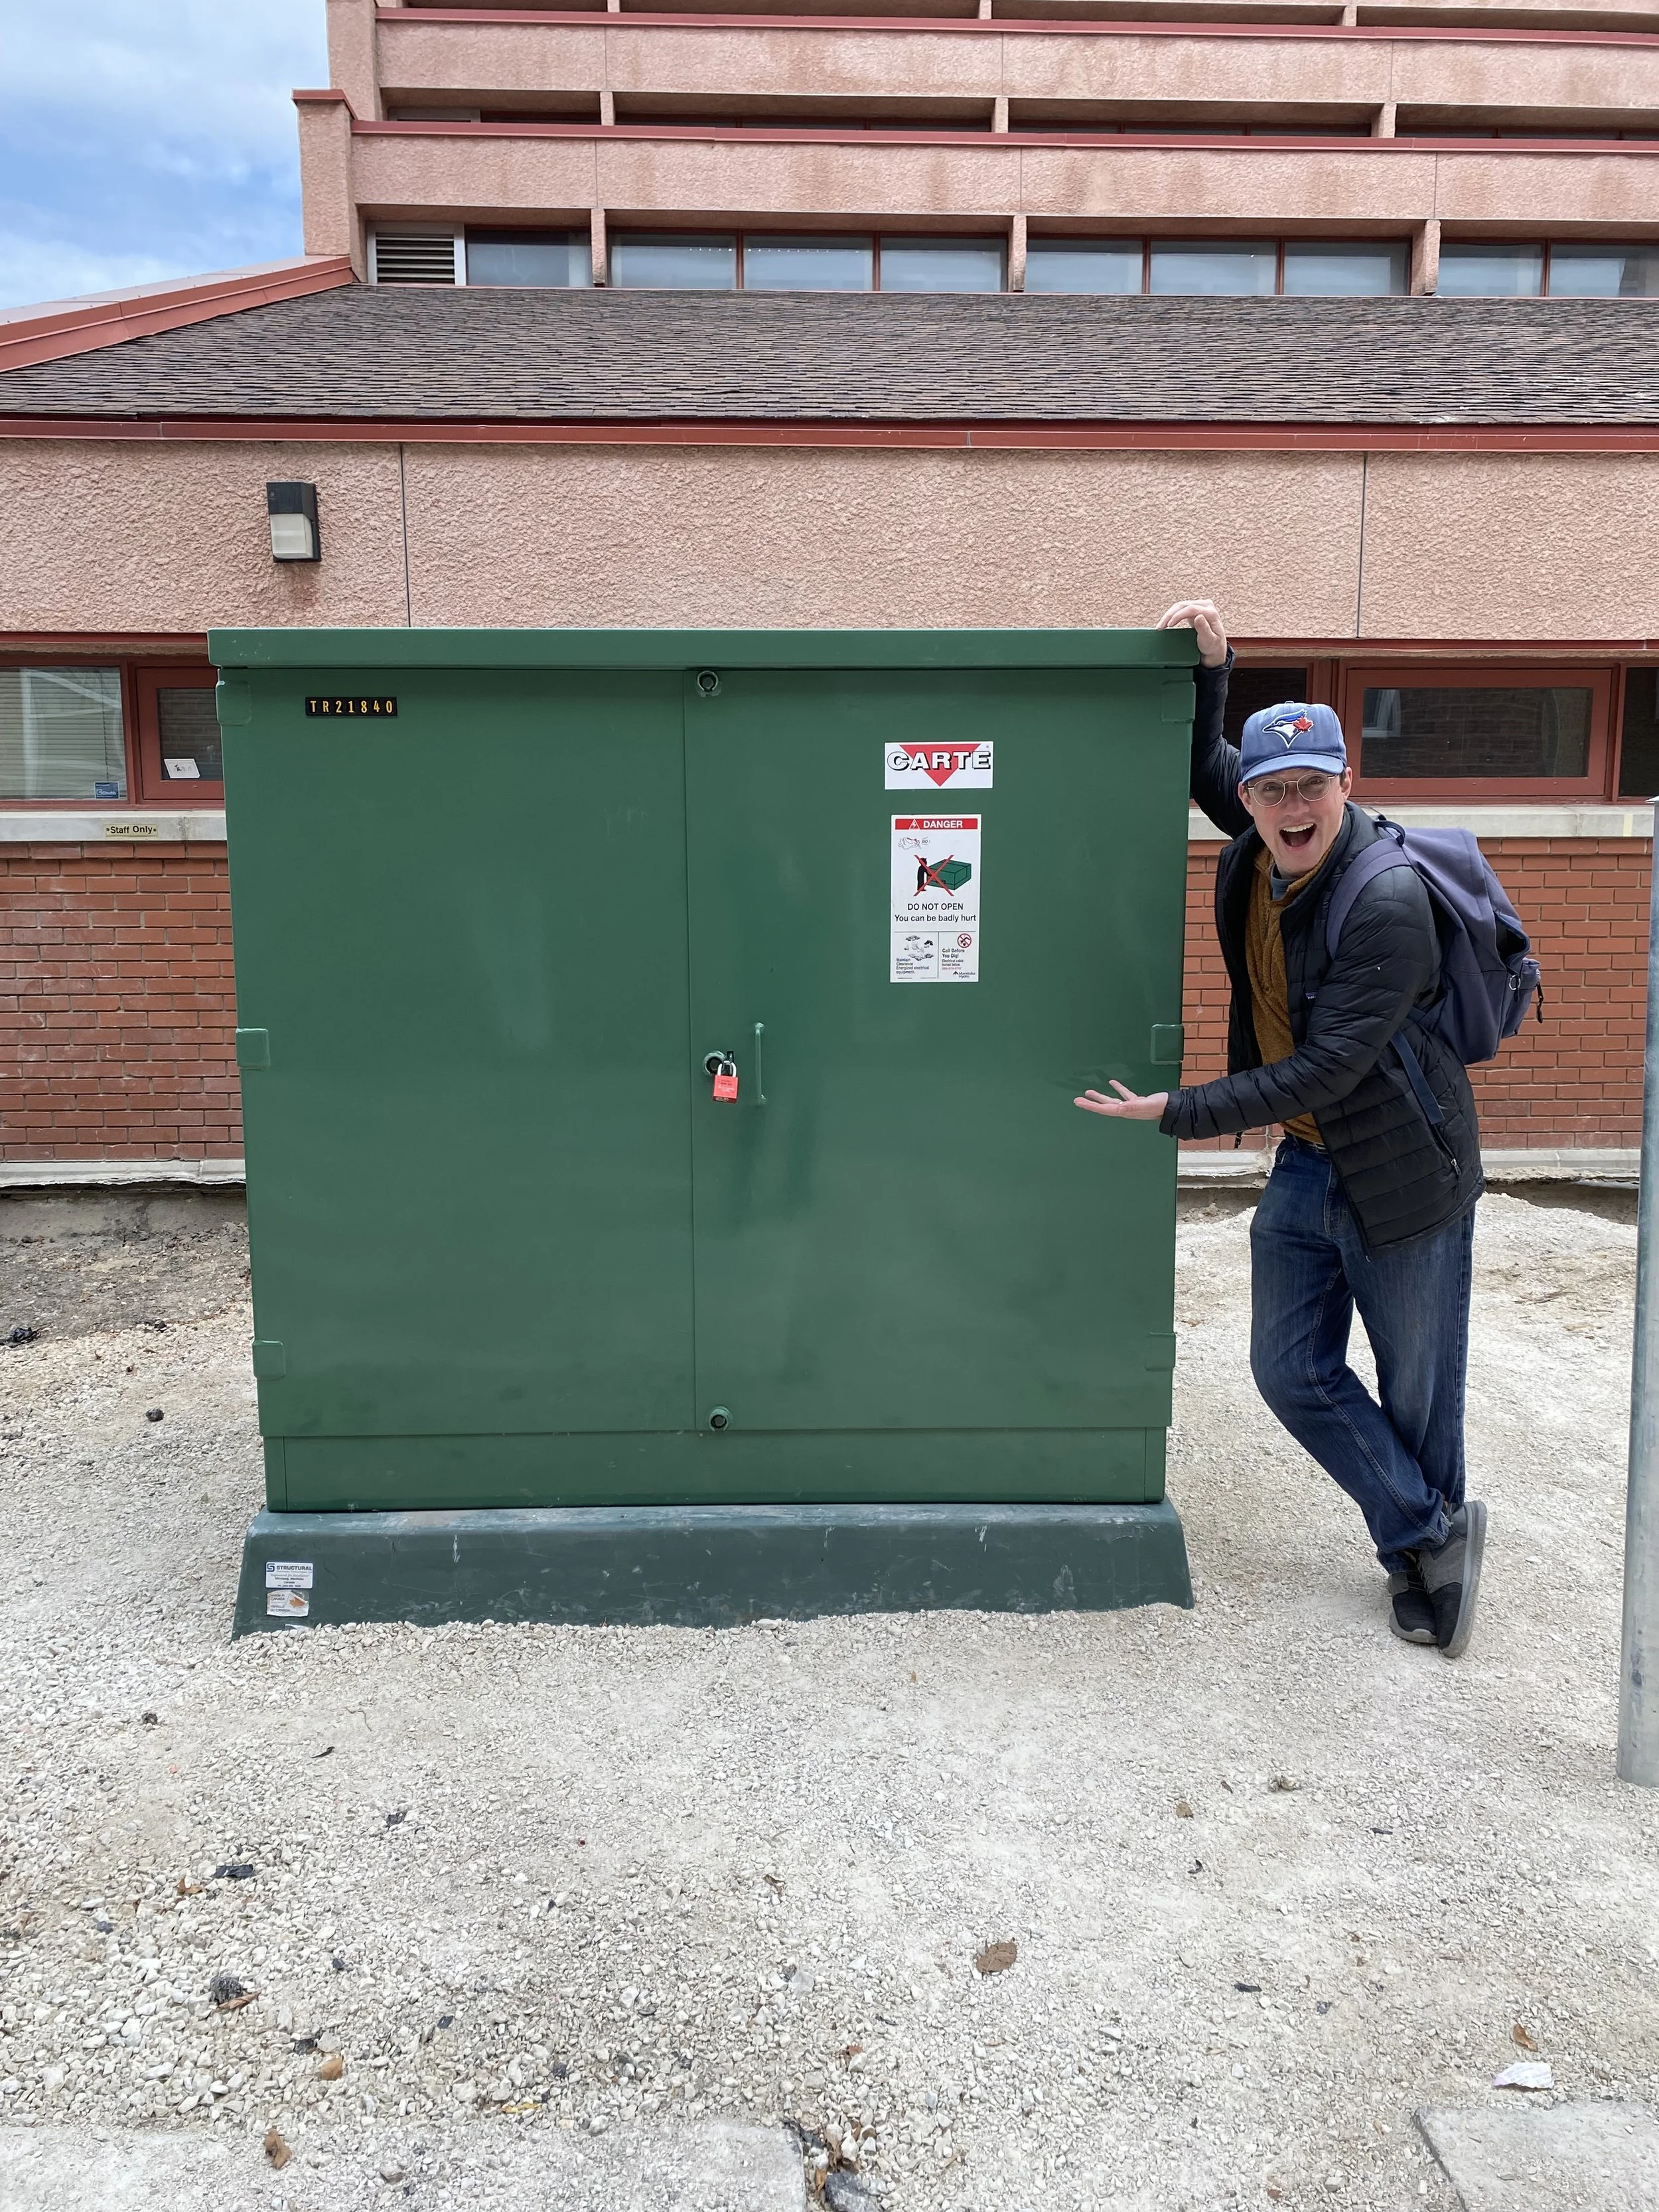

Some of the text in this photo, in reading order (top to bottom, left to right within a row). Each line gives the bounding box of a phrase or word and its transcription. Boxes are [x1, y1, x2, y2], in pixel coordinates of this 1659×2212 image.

[310, 700, 393, 713] TR21840
[887, 751, 991, 771] CARTE
[133, 826, 153, 834] Only
